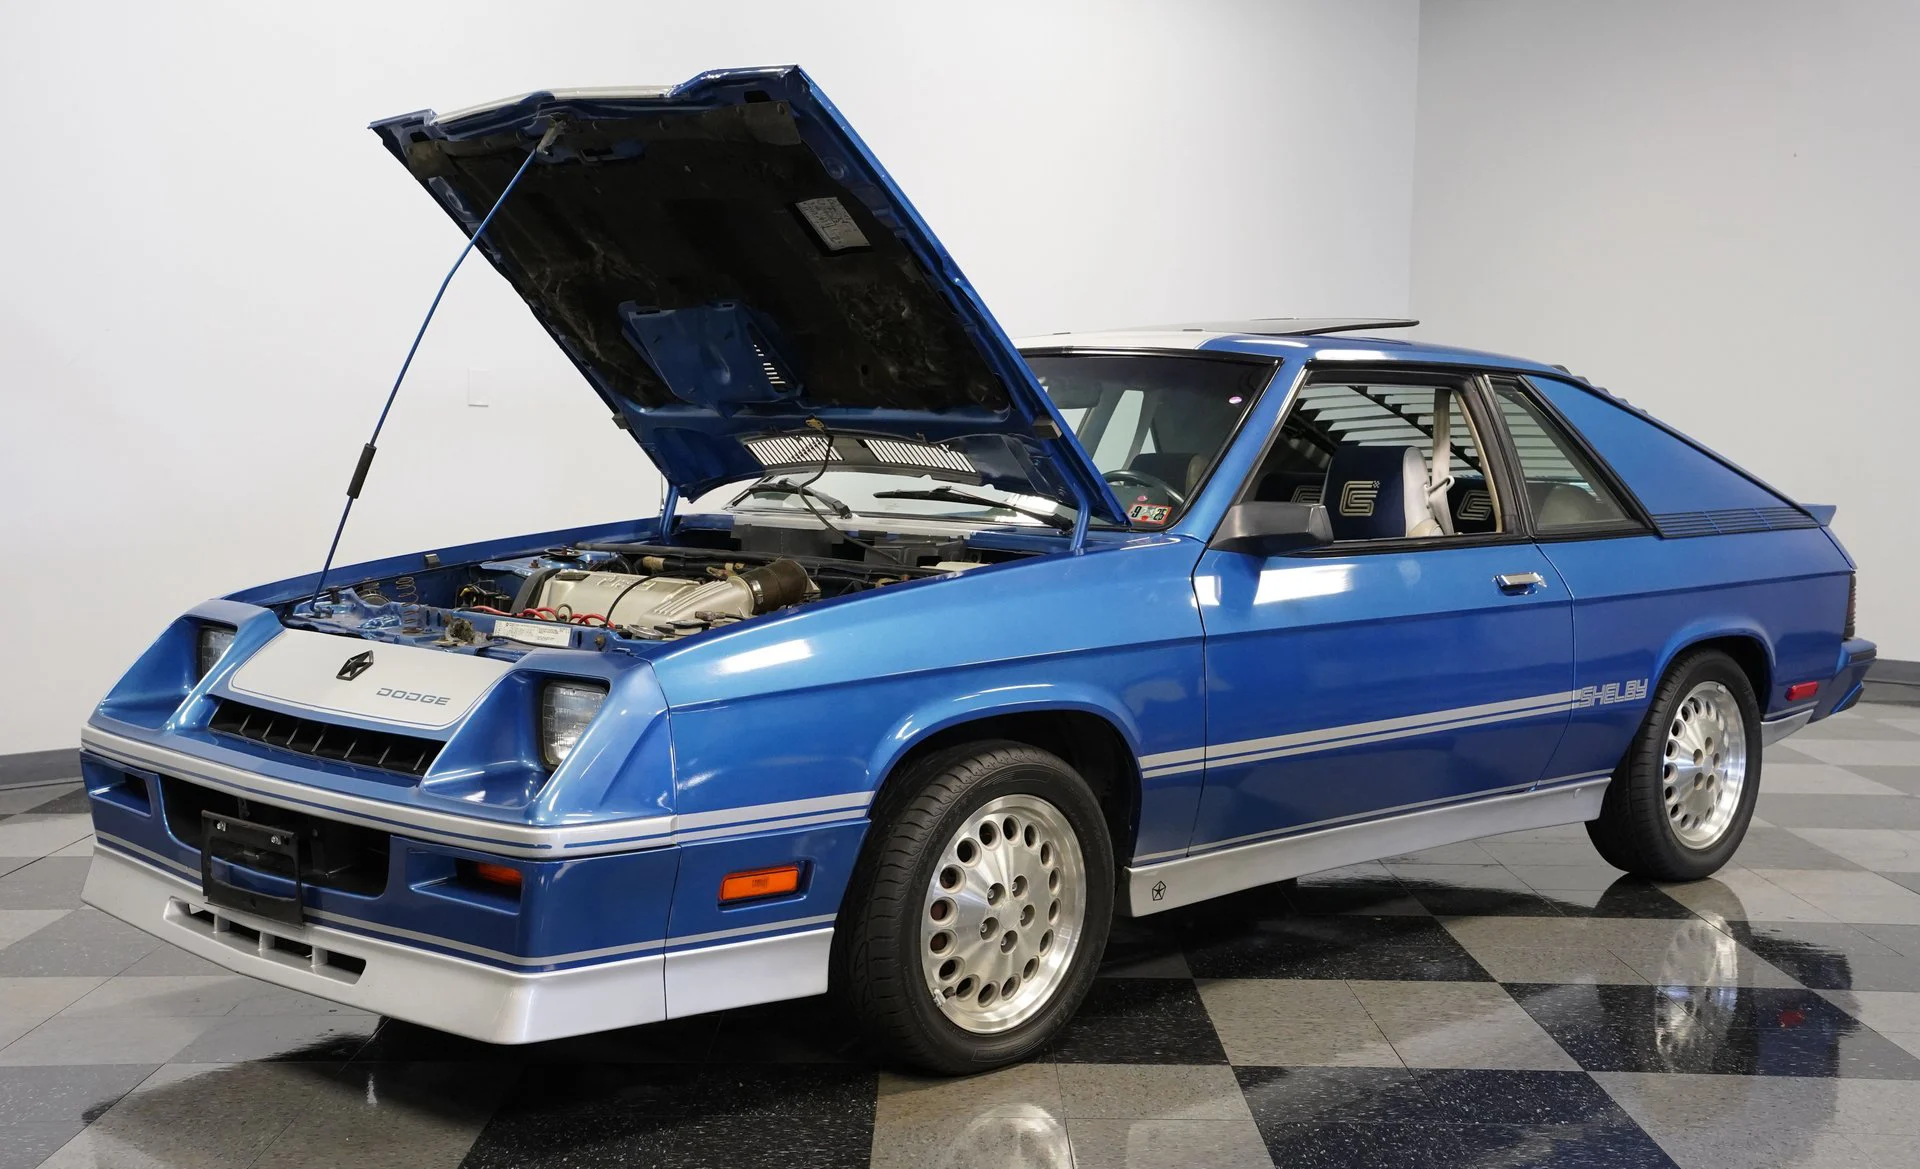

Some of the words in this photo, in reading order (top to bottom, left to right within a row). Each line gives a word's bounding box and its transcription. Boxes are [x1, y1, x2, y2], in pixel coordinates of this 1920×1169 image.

[1153, 508, 1167, 520] 25
[376, 687, 451, 706] DODGE
[1579, 678, 1649, 708] SHELBY
